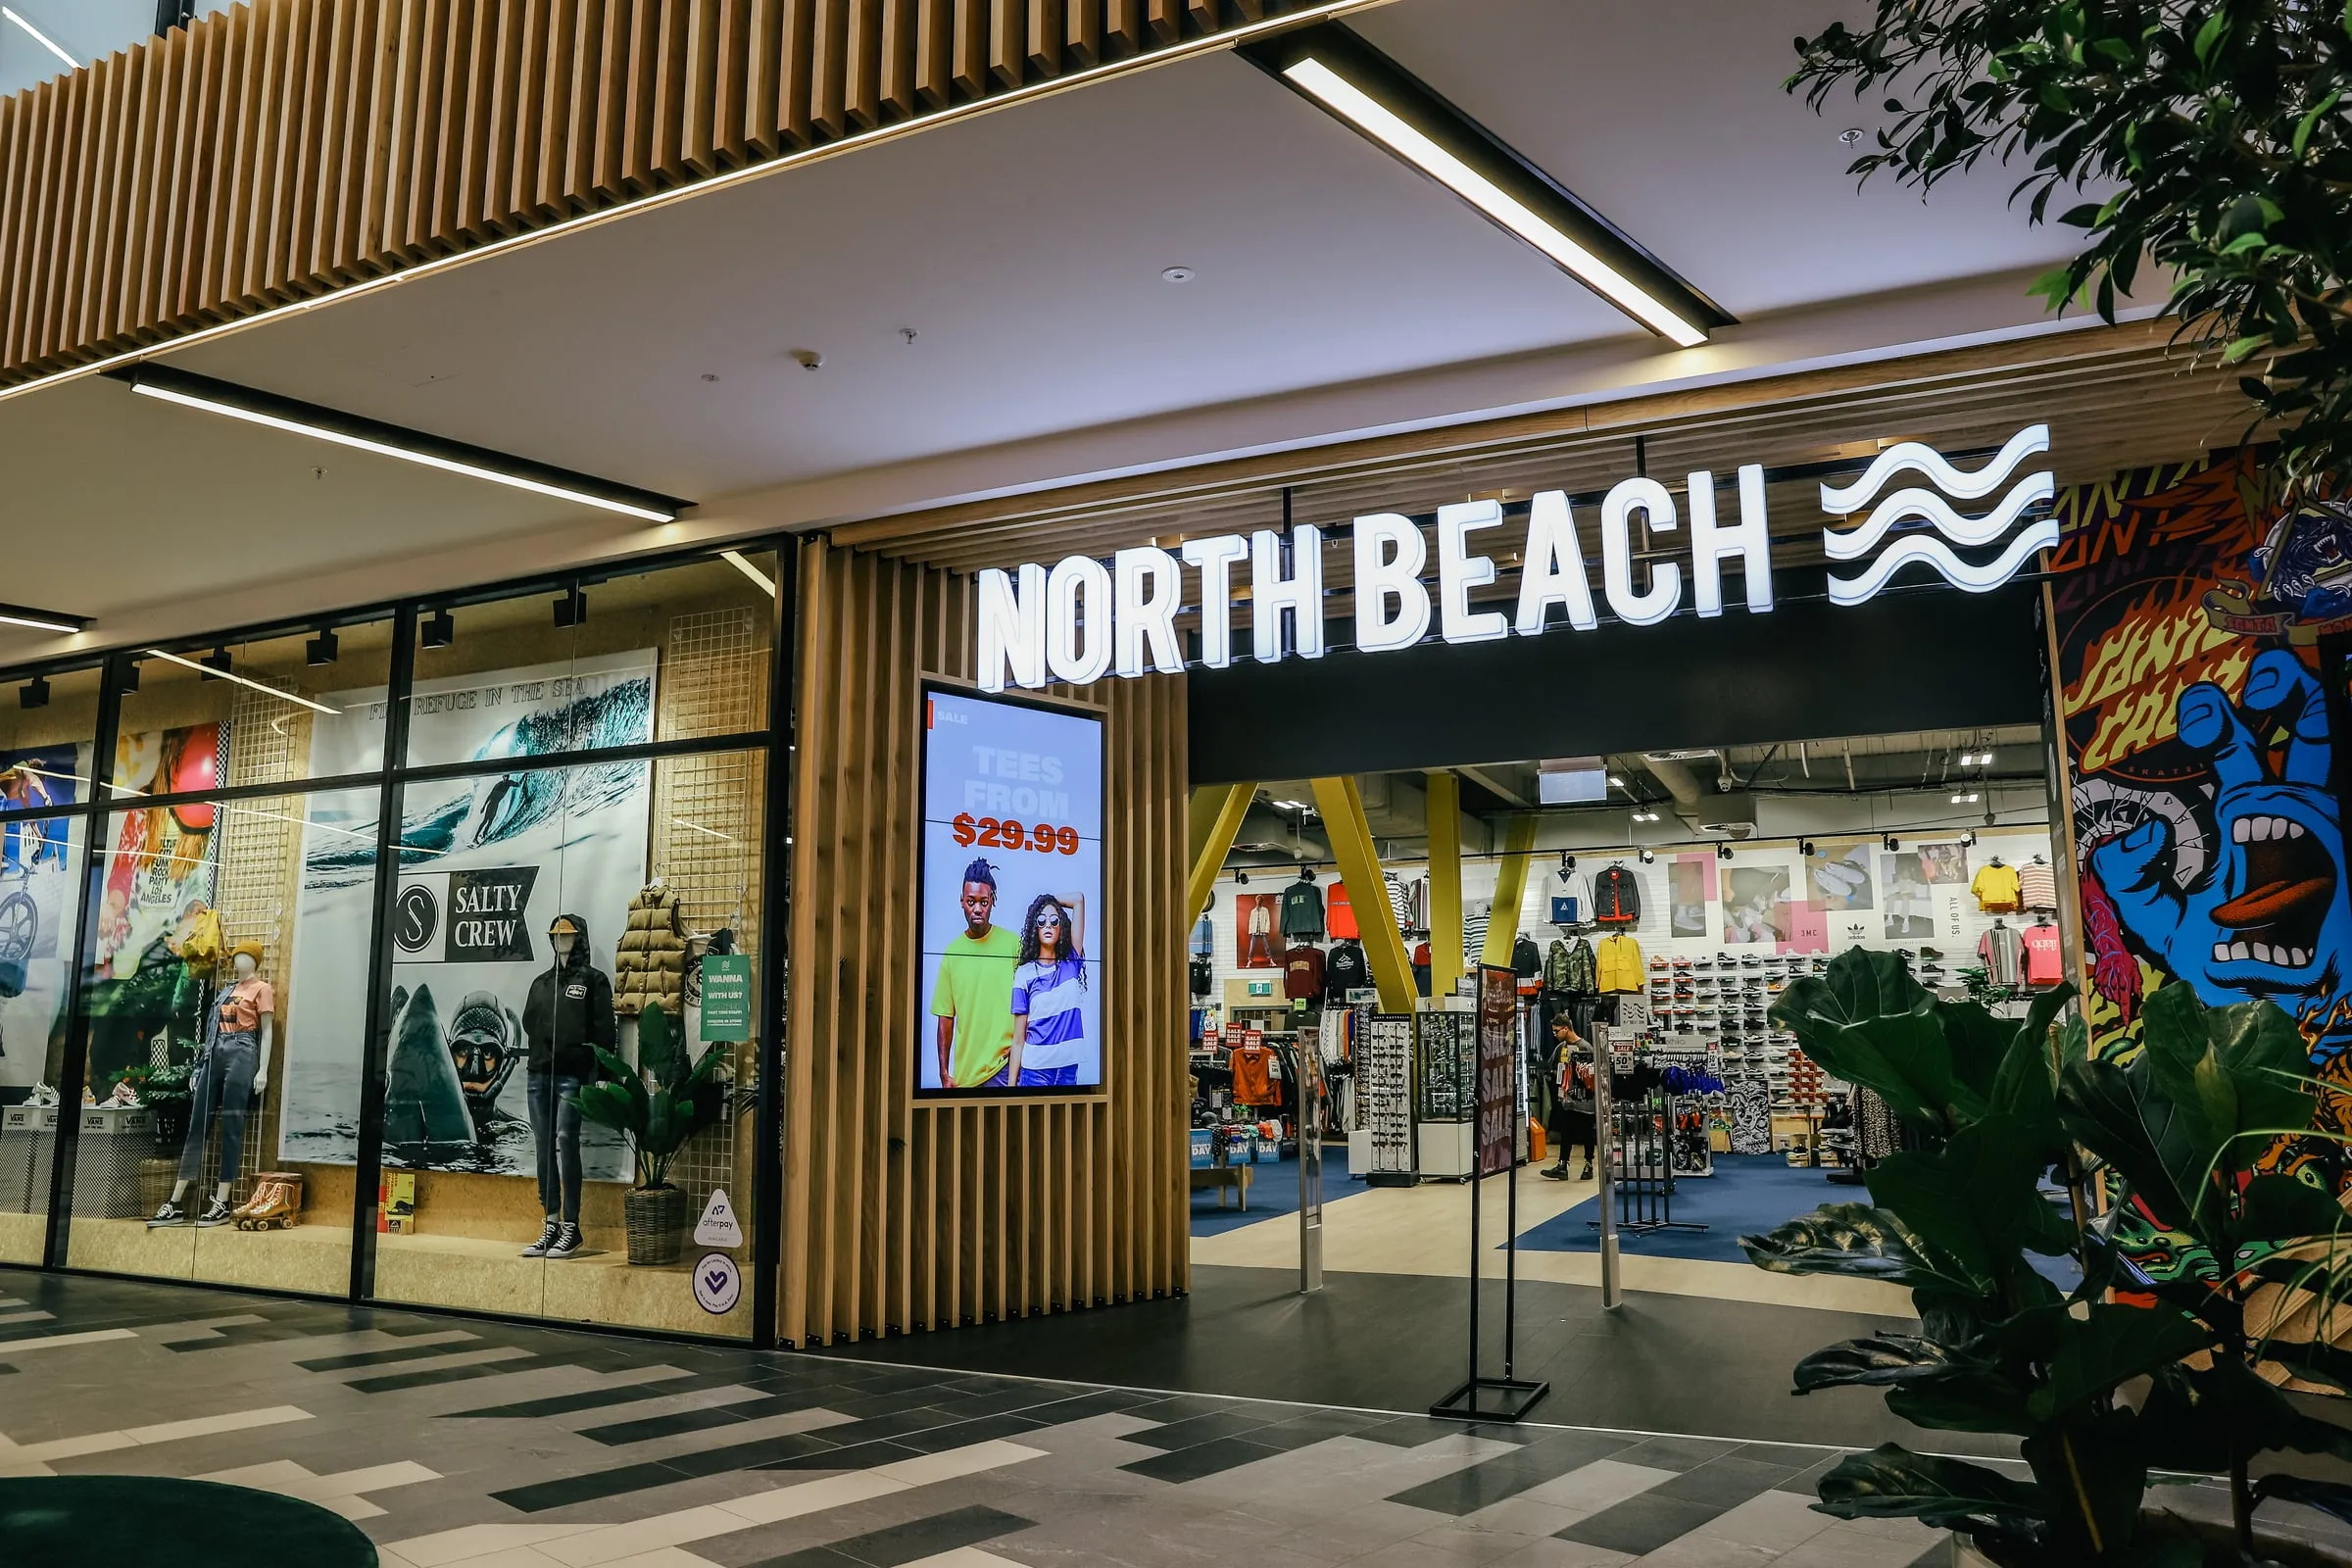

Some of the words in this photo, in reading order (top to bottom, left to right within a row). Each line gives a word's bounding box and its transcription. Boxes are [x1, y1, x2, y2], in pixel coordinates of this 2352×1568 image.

[978, 523, 1324, 693] NORTH
[1354, 463, 1775, 654] BEACH
[414, 691, 478, 715] REFUGE
[485, 687, 503, 708] IN
[512, 681, 545, 704] THE
[552, 676, 586, 698] SEA
[937, 710, 968, 725] SALE
[972, 745, 1064, 783] TEES
[964, 779, 1069, 820] FROM
[953, 811, 1080, 857] $29.99
[152, 867, 170, 877] ROCK
[149, 876, 170, 886] PARTY
[151, 886, 163, 895] LOS
[140, 893, 172, 904] ANGELES
[455, 884, 522, 914] SALTY
[1949, 896, 1958, 910] ALL
[1950, 912, 1960, 922] OF
[454, 919, 517, 948] CREW
[1951, 924, 1961, 938] US.
[709, 974, 743, 983] WANNA
[1482, 1060, 1513, 1103] SALE
[10, 1113, 24, 1122] VANS
[46, 1114, 58, 1123] VAN
[86, 1116, 104, 1125] VANS
[125, 1116, 146, 1125] VANS
[1482, 1104, 1512, 1147] SALE
[1192, 1147, 1211, 1155] DAY
[1229, 1145, 1249, 1153] DAY
[703, 1218, 734, 1231] afterpay
